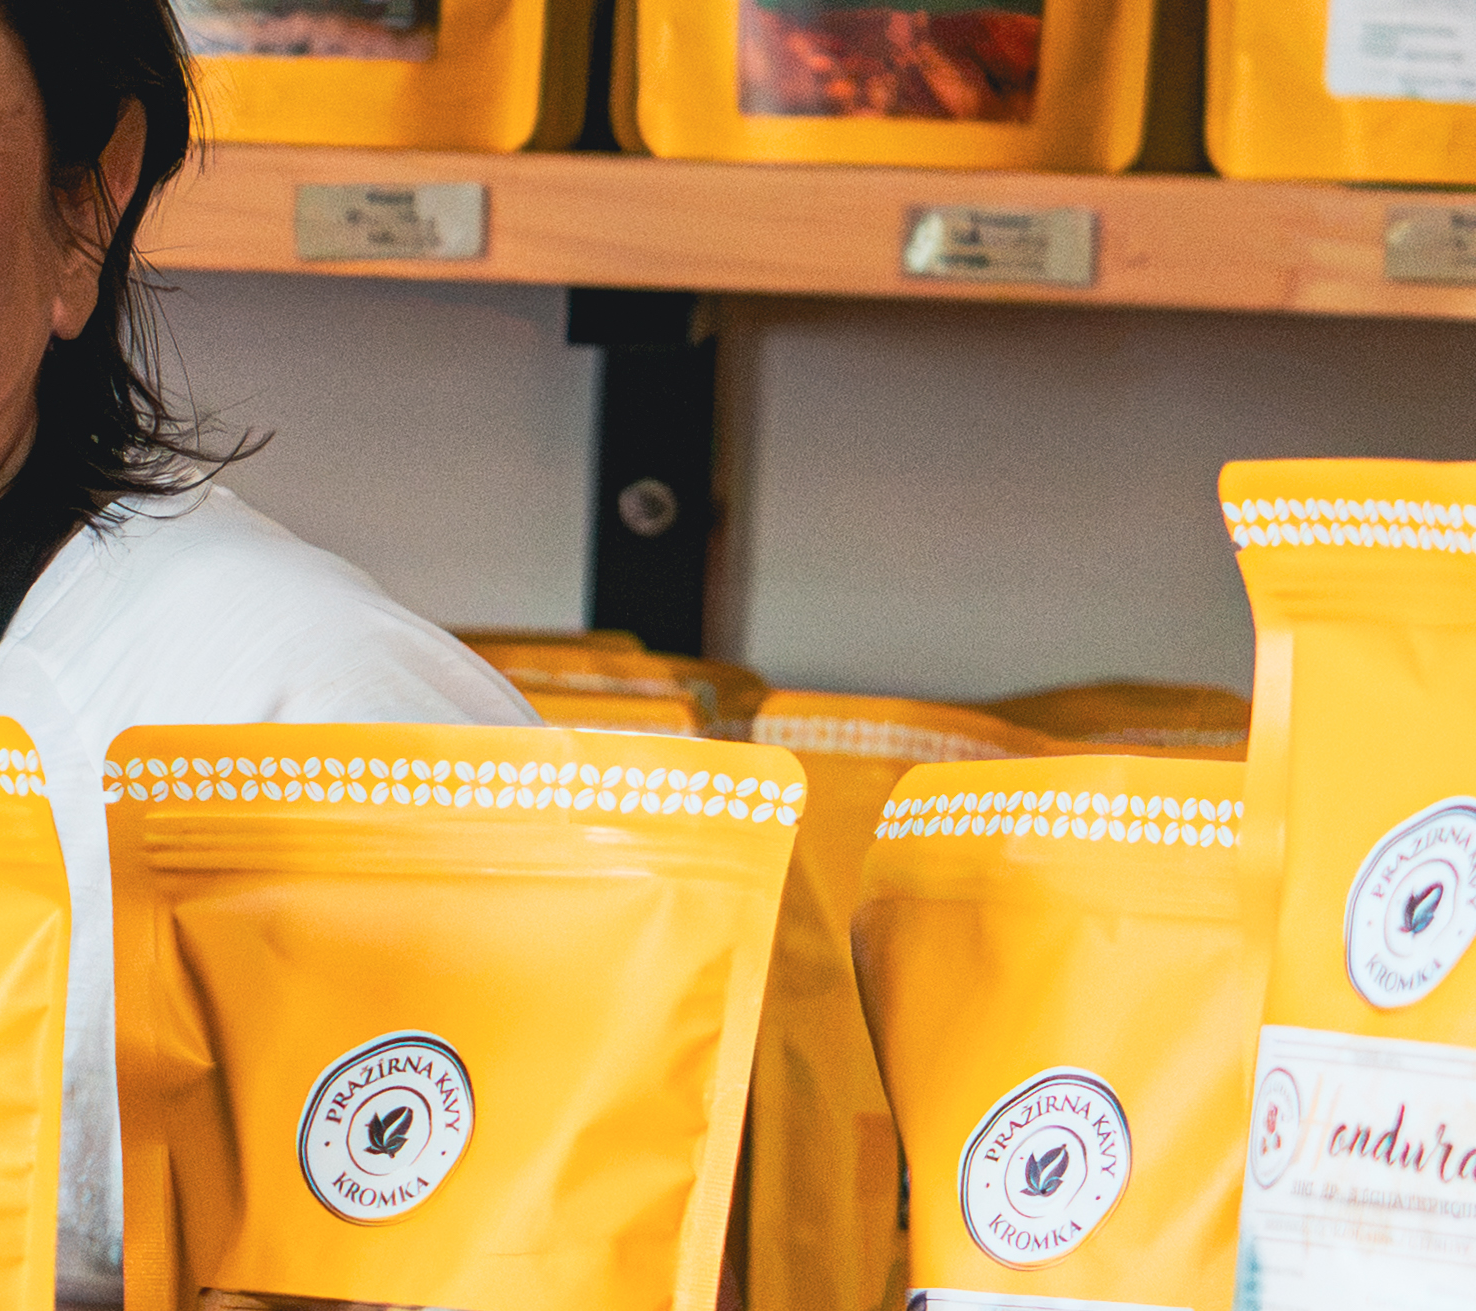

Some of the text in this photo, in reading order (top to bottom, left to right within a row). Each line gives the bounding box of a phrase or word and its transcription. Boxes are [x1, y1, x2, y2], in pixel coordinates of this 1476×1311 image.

[324, 1054, 462, 1134] PRAŽÍRNA KÁVY
[983, 1093, 1118, 1180] PRAŽÍRNA KÁVY
[331, 1170, 431, 1210] KROMKA
[988, 1211, 1084, 1254] KROMKA
